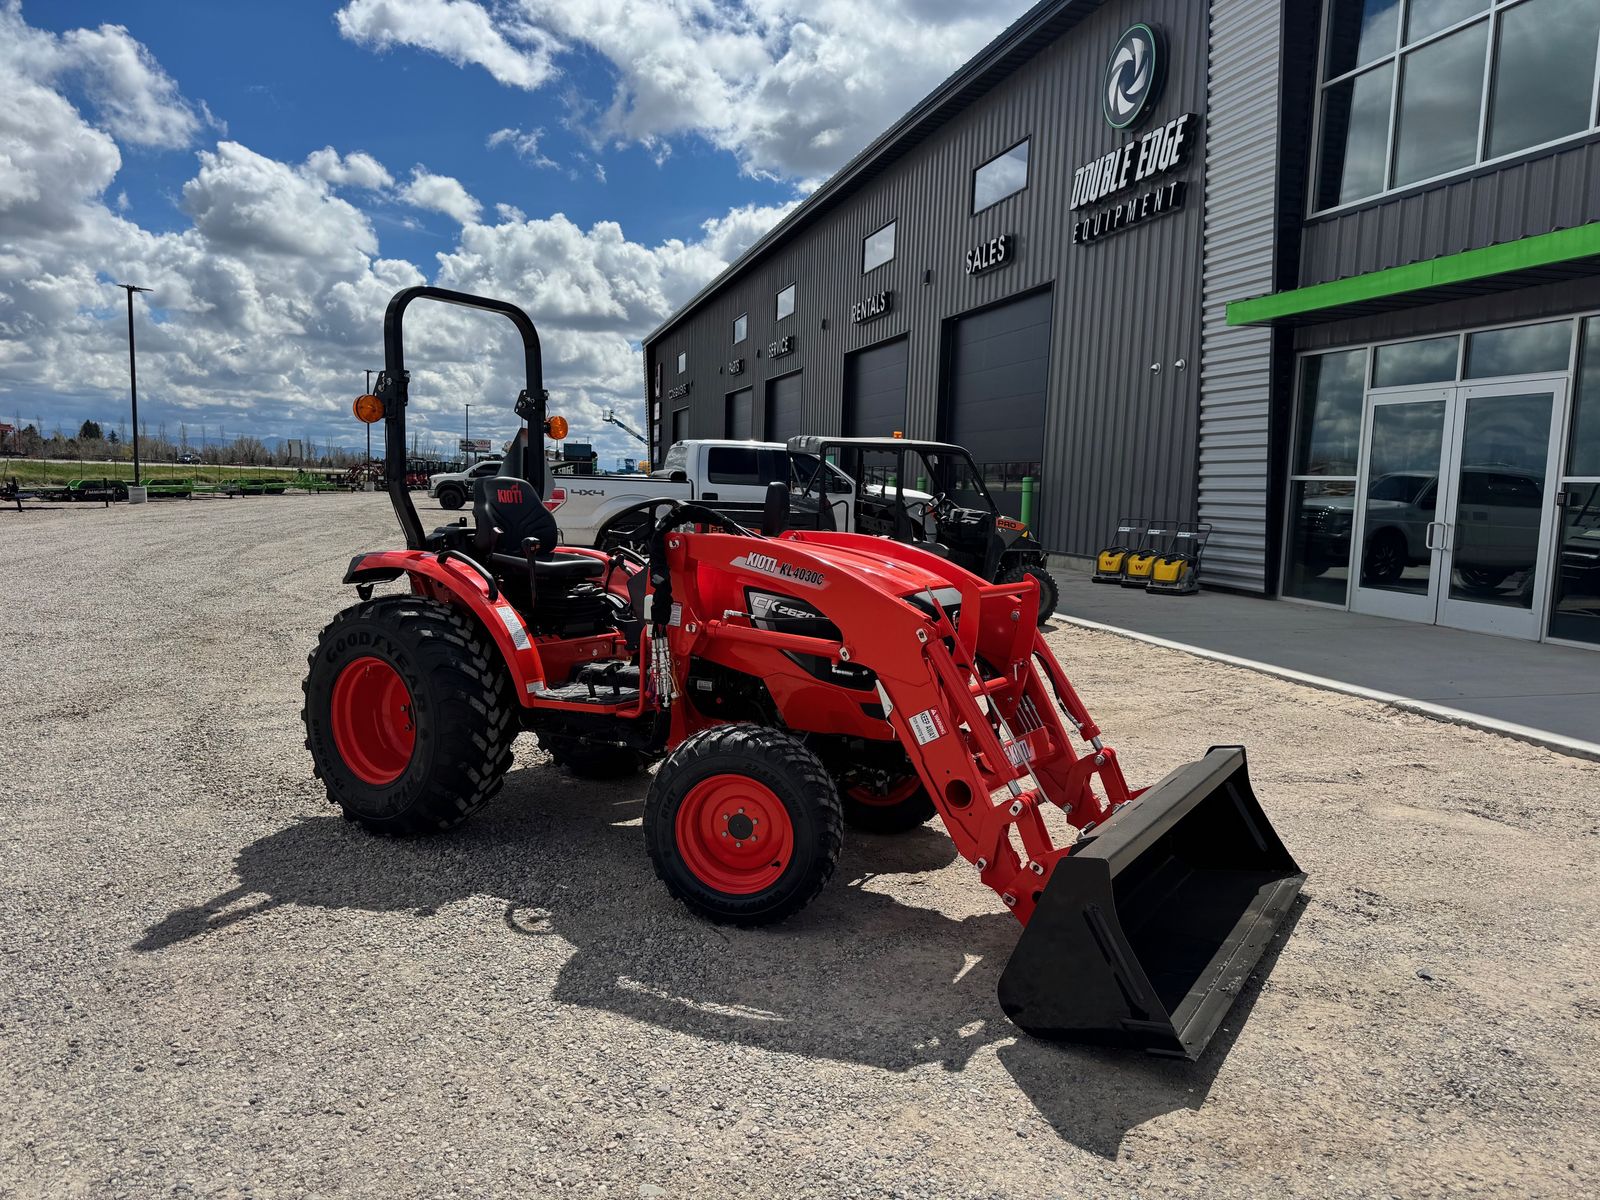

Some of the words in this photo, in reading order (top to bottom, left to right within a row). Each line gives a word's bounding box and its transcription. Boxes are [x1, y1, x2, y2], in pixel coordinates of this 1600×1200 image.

[1070, 141, 1135, 211] DOUBLE
[1135, 113, 1189, 182] EDGE
[1072, 181, 1177, 244] EQUIPMENT
[965, 234, 1005, 275] SALES
[852, 291, 886, 323] RENTALS
[497, 486, 523, 504] KIOTI
[997, 519, 1017, 528] PRO
[745, 552, 778, 573] KIOTI
[780, 563, 825, 585] KL4030C
[920, 712, 930, 725] KEEP
[925, 725, 936, 739] AWAY
